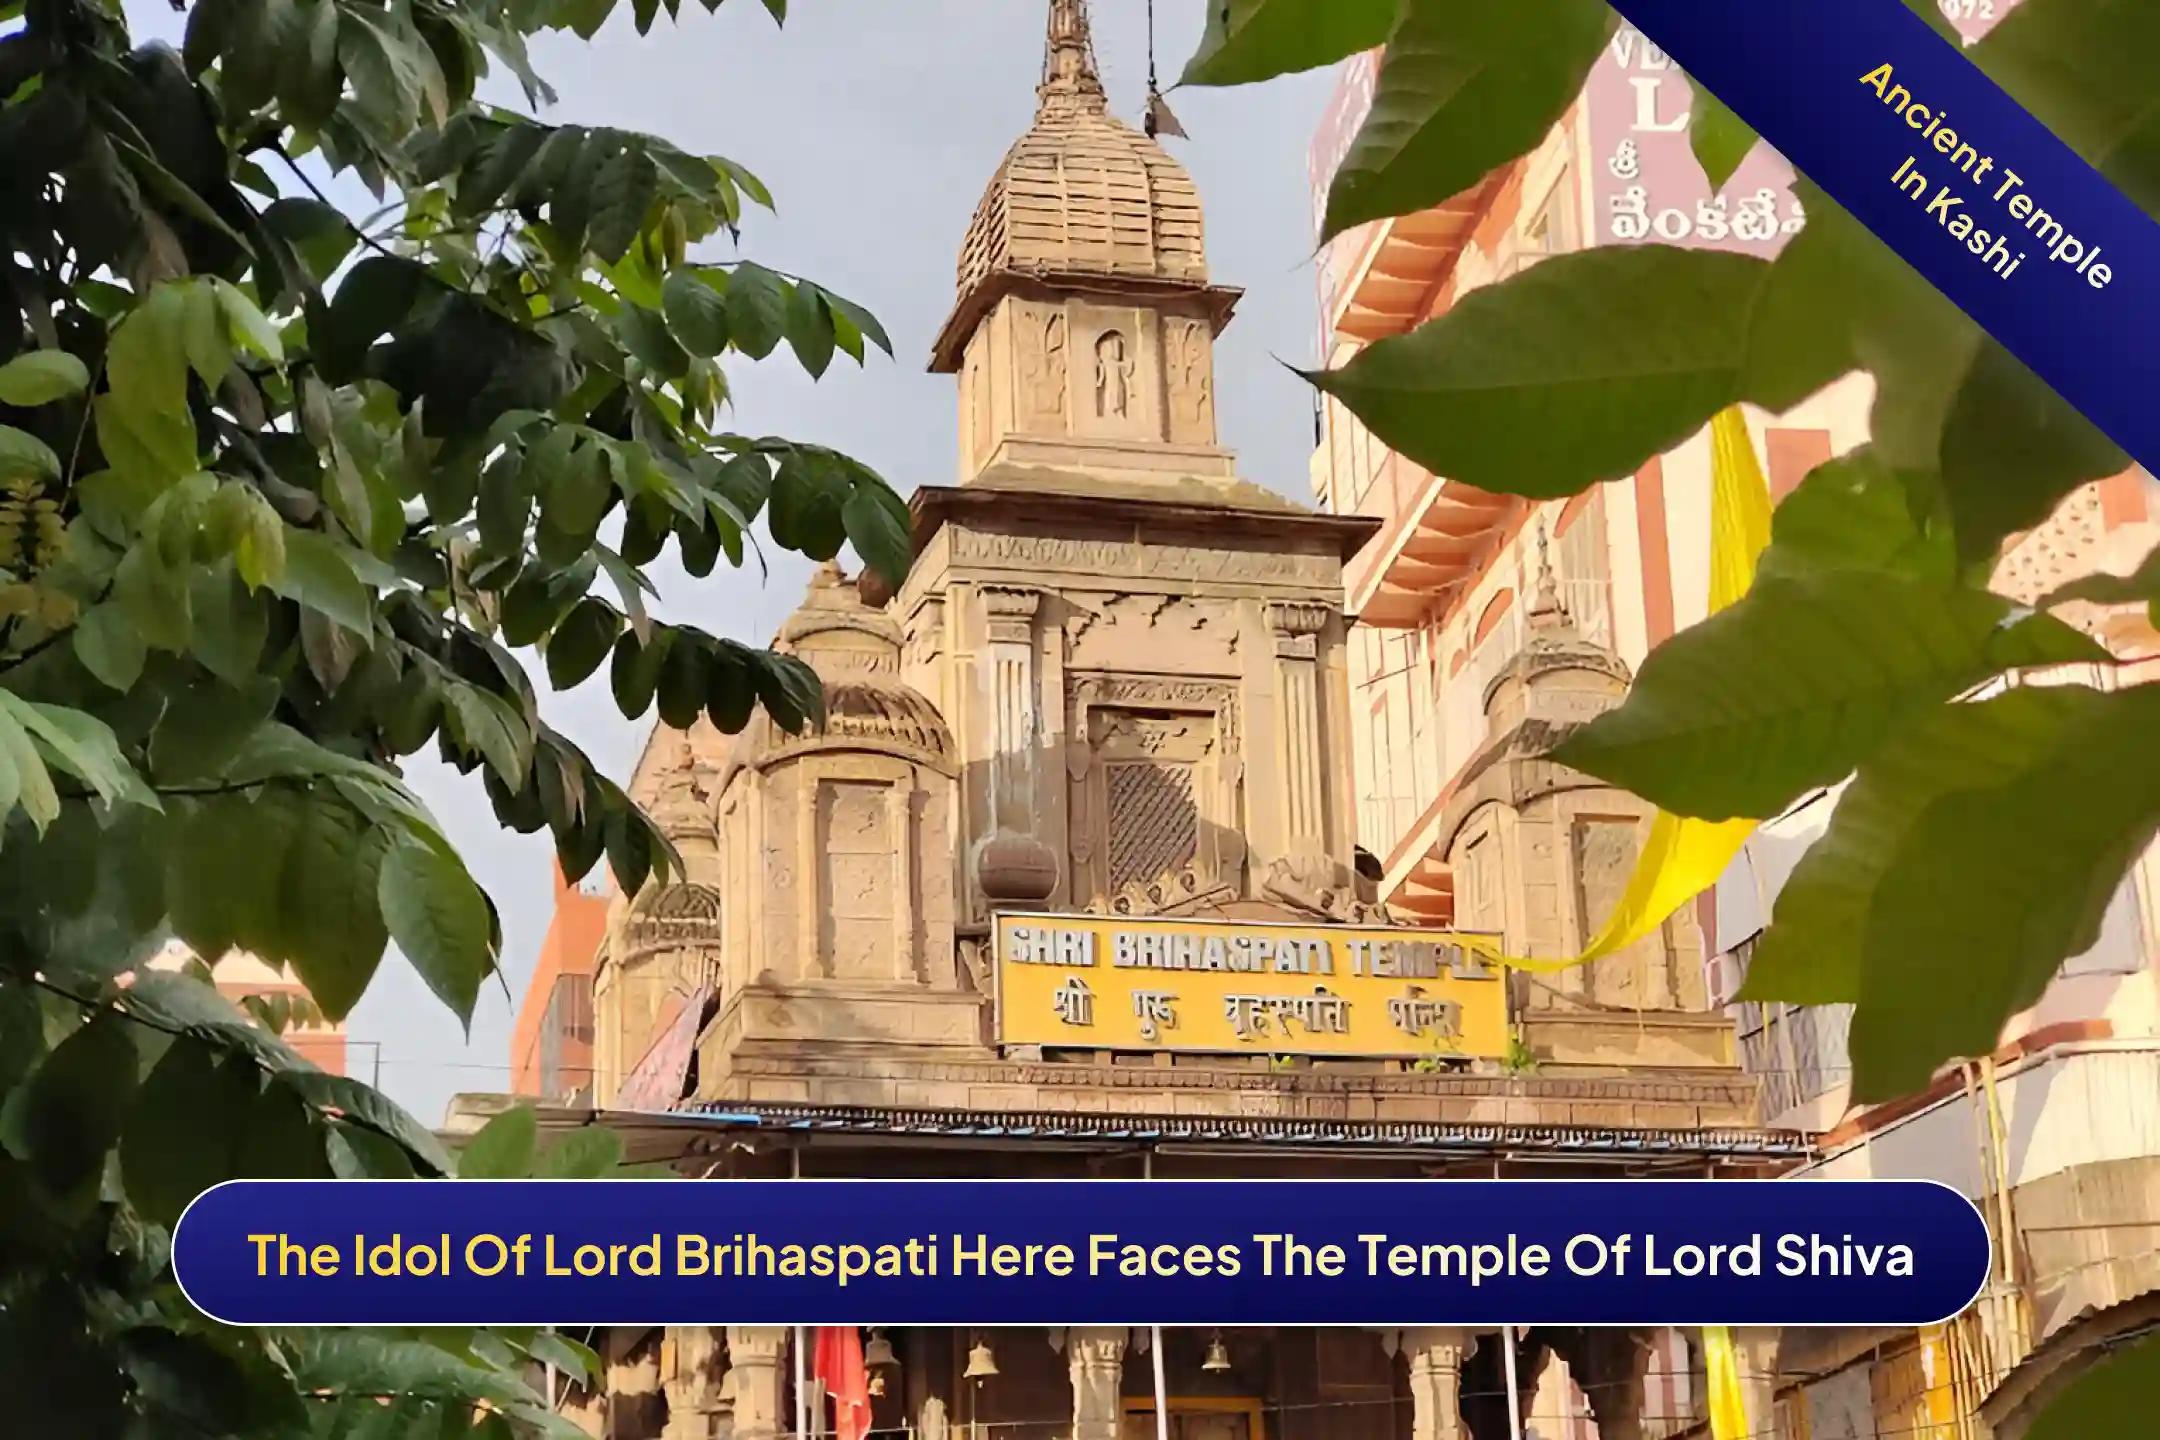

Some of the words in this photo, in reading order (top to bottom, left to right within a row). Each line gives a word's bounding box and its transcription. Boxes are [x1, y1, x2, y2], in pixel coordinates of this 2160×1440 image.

[1009, 927, 1097, 967] SHRI
[1112, 932, 1335, 976] BRIHASPATI
[1053, 975, 1095, 1025] श्री
